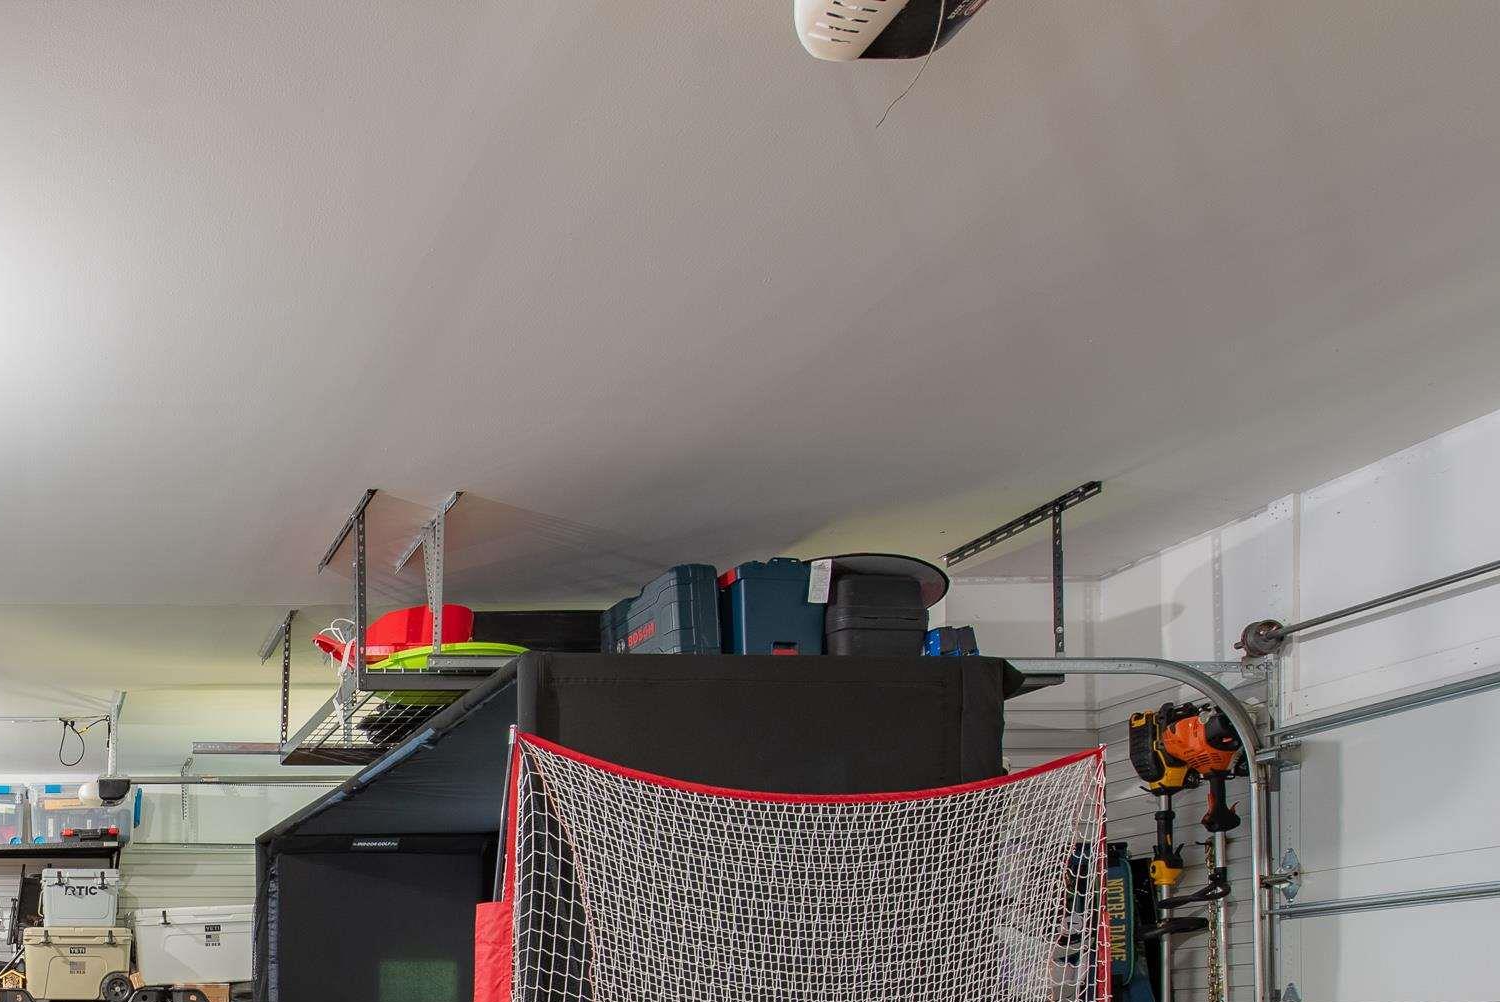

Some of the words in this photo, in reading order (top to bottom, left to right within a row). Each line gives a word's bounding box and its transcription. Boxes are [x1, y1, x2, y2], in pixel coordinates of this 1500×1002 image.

[627, 620, 656, 648] BOSCH
[64, 885, 98, 896] RTIC
[1107, 878, 1126, 920] NOTRE
[1109, 924, 1127, 961] DAME
